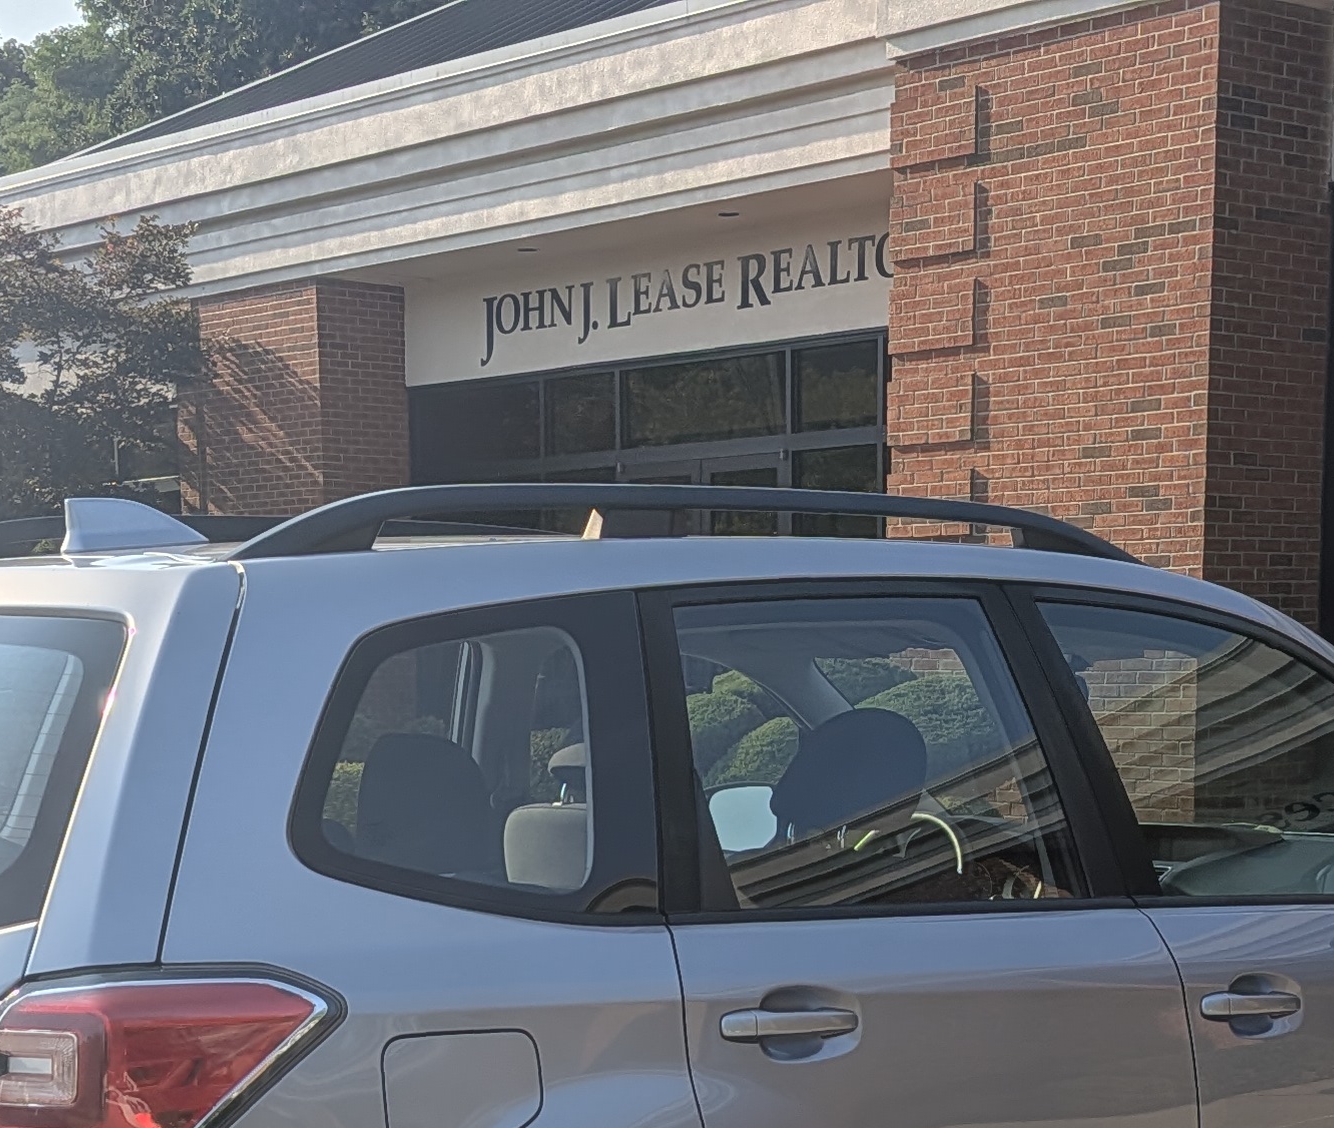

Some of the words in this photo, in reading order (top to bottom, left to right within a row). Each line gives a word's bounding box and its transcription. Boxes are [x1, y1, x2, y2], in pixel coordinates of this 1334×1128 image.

[480, 285, 573, 367] JOHN
[578, 281, 599, 344] J.
[606, 258, 726, 329] LEASE
